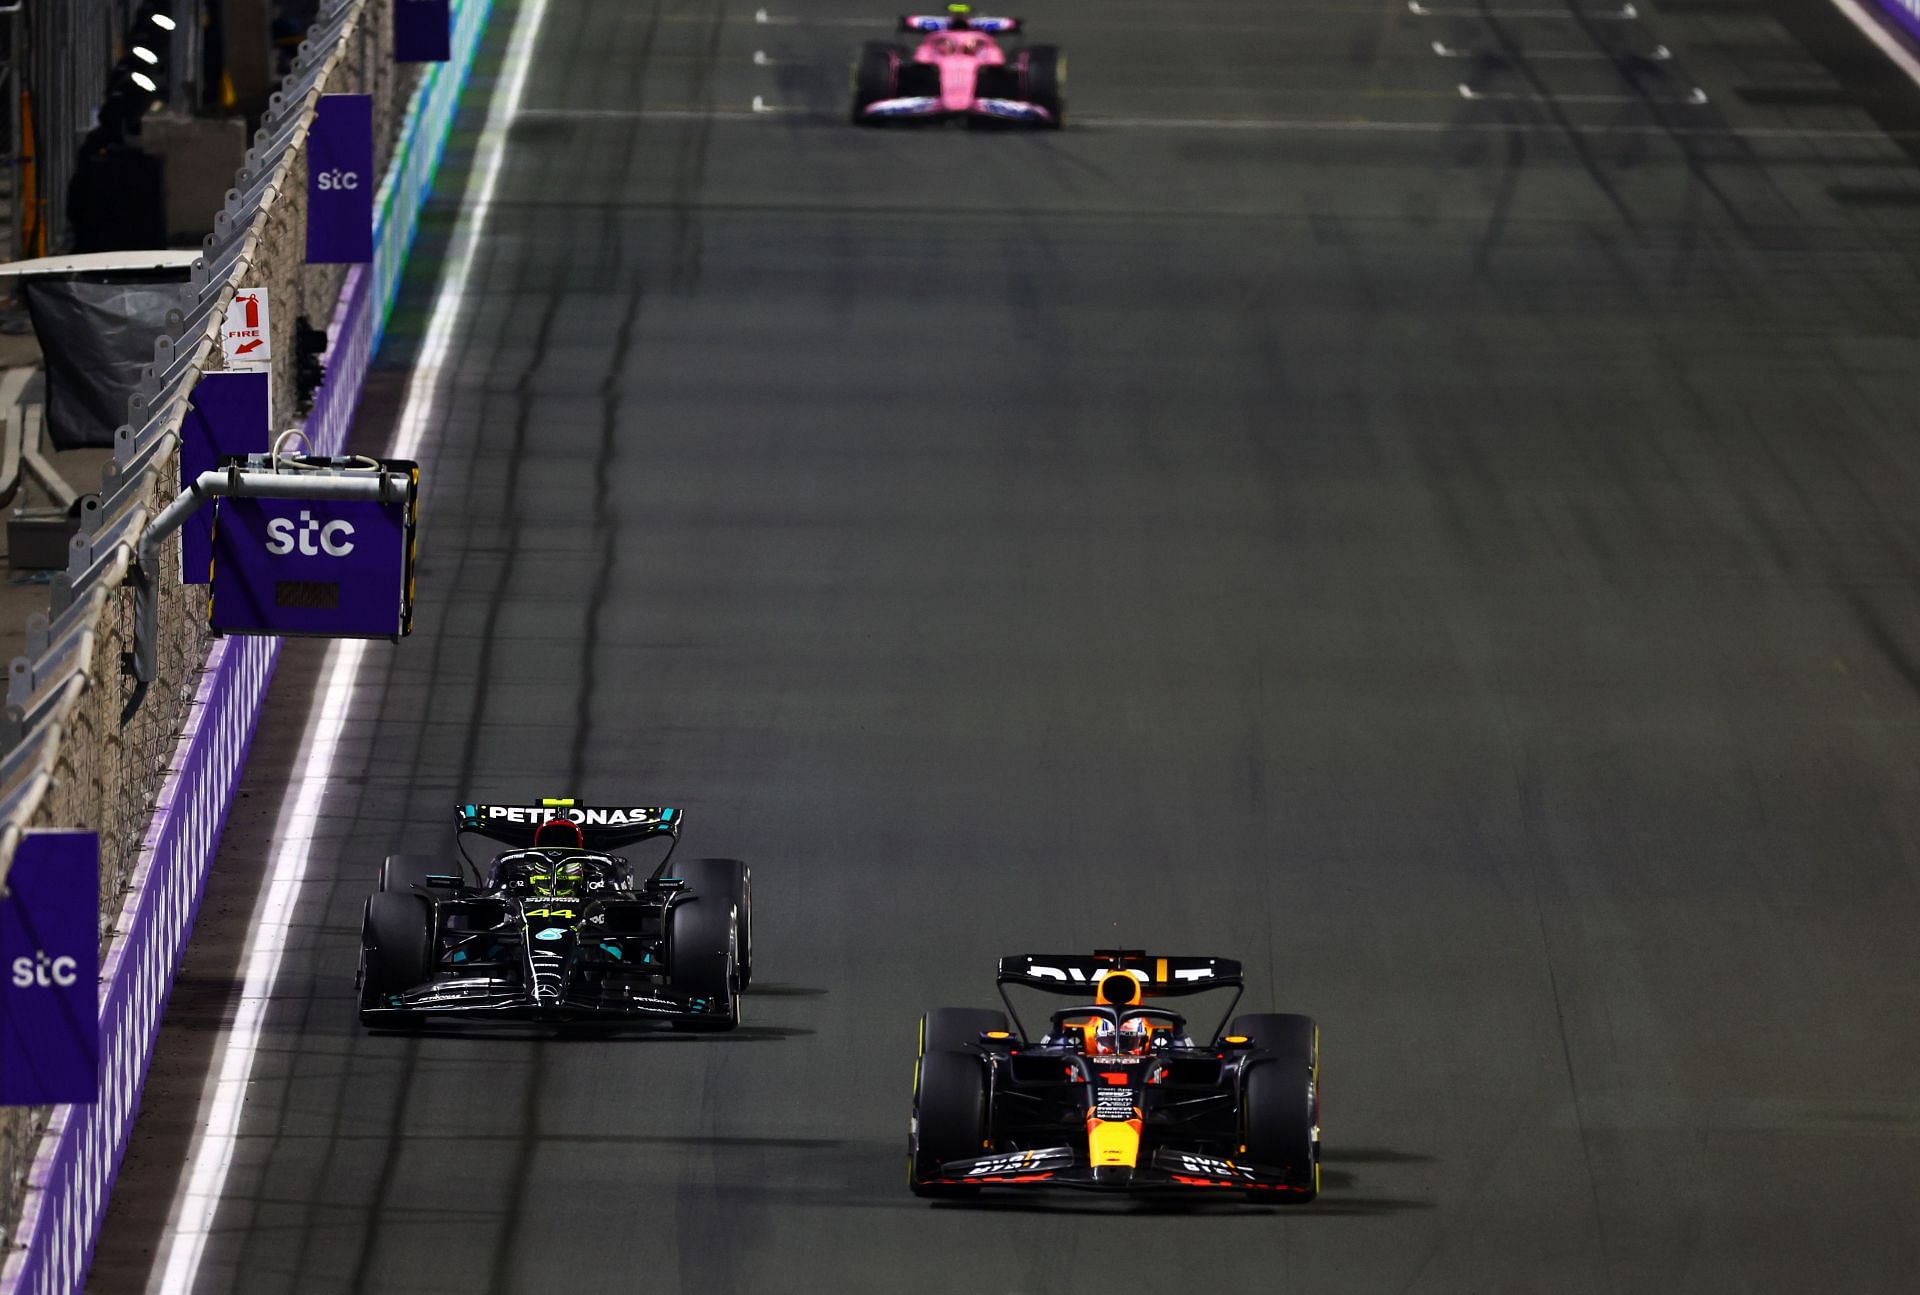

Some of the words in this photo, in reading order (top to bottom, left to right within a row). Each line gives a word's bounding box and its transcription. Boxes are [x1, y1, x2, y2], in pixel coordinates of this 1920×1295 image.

[317, 168, 358, 191] stc
[229, 329, 260, 339] FIRE
[265, 510, 355, 557] stc
[525, 908, 577, 919] 44
[12, 950, 77, 987] stc
[1099, 1073, 1128, 1084] 1
